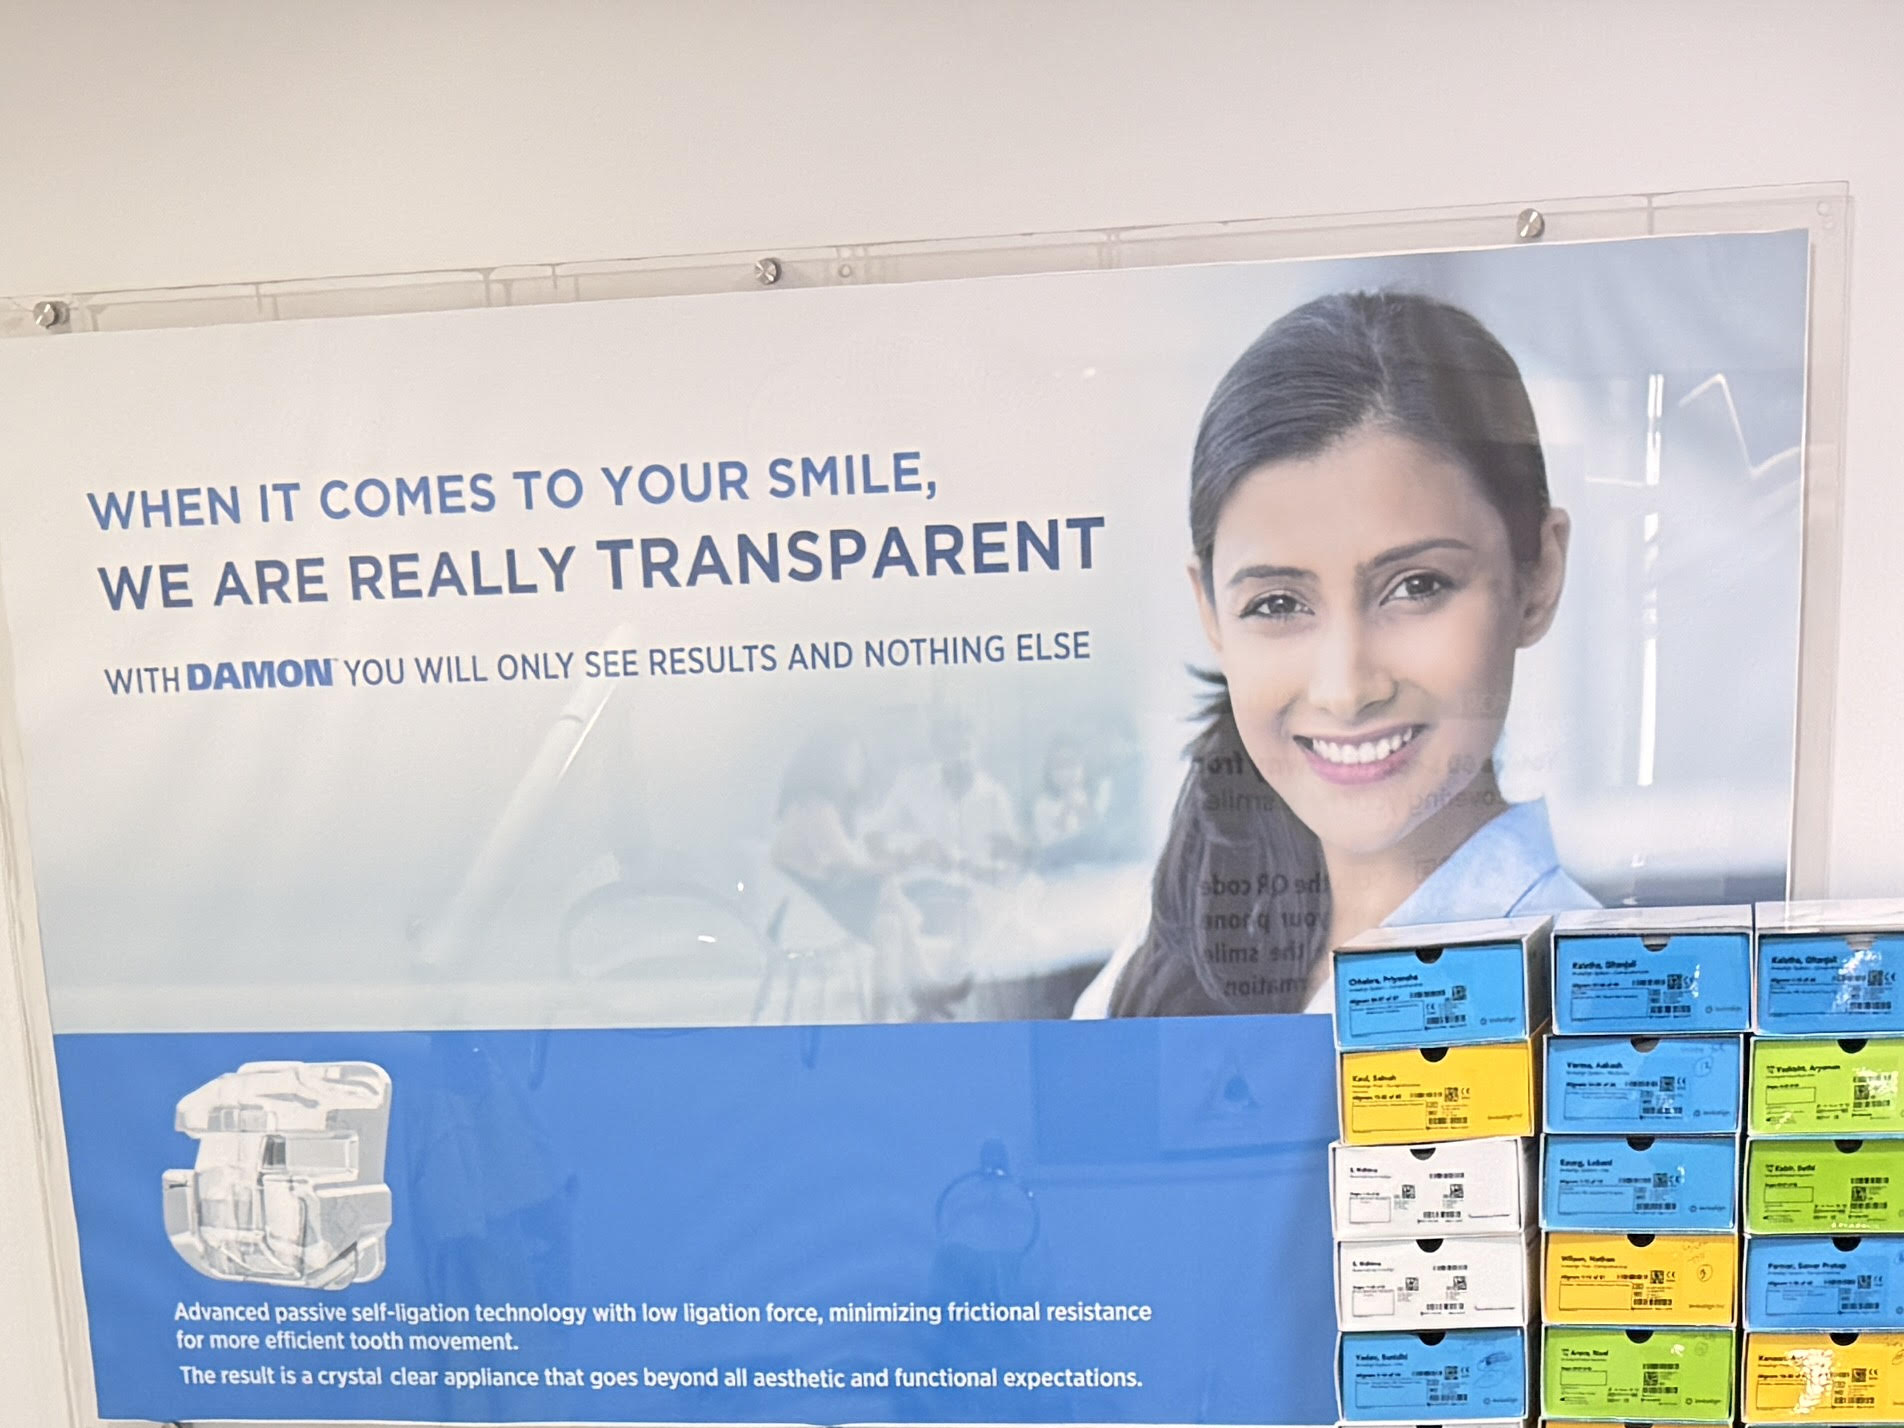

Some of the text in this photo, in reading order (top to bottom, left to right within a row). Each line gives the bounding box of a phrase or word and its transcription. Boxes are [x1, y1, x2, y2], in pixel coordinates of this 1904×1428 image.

[87, 452, 936, 530] WHEN IT COMES TO YOUR SMILE,
[98, 517, 1104, 610] WE ARE REALLY TRANSPARENT
[104, 631, 1090, 694] WITH DAMON YOU WILL ONLY SEE RESULTS AND NOTHING ELSE
[175, 1302, 1152, 1325] Advanced passive self-ligation technology with low ligation force, minimizing frictional resistance
[177, 1330, 518, 1350] for more efficient tooth movement.
[180, 1366, 1142, 1389] The result is a crystal clear appliance that goes beyond all aesthetic and functional expectations.
